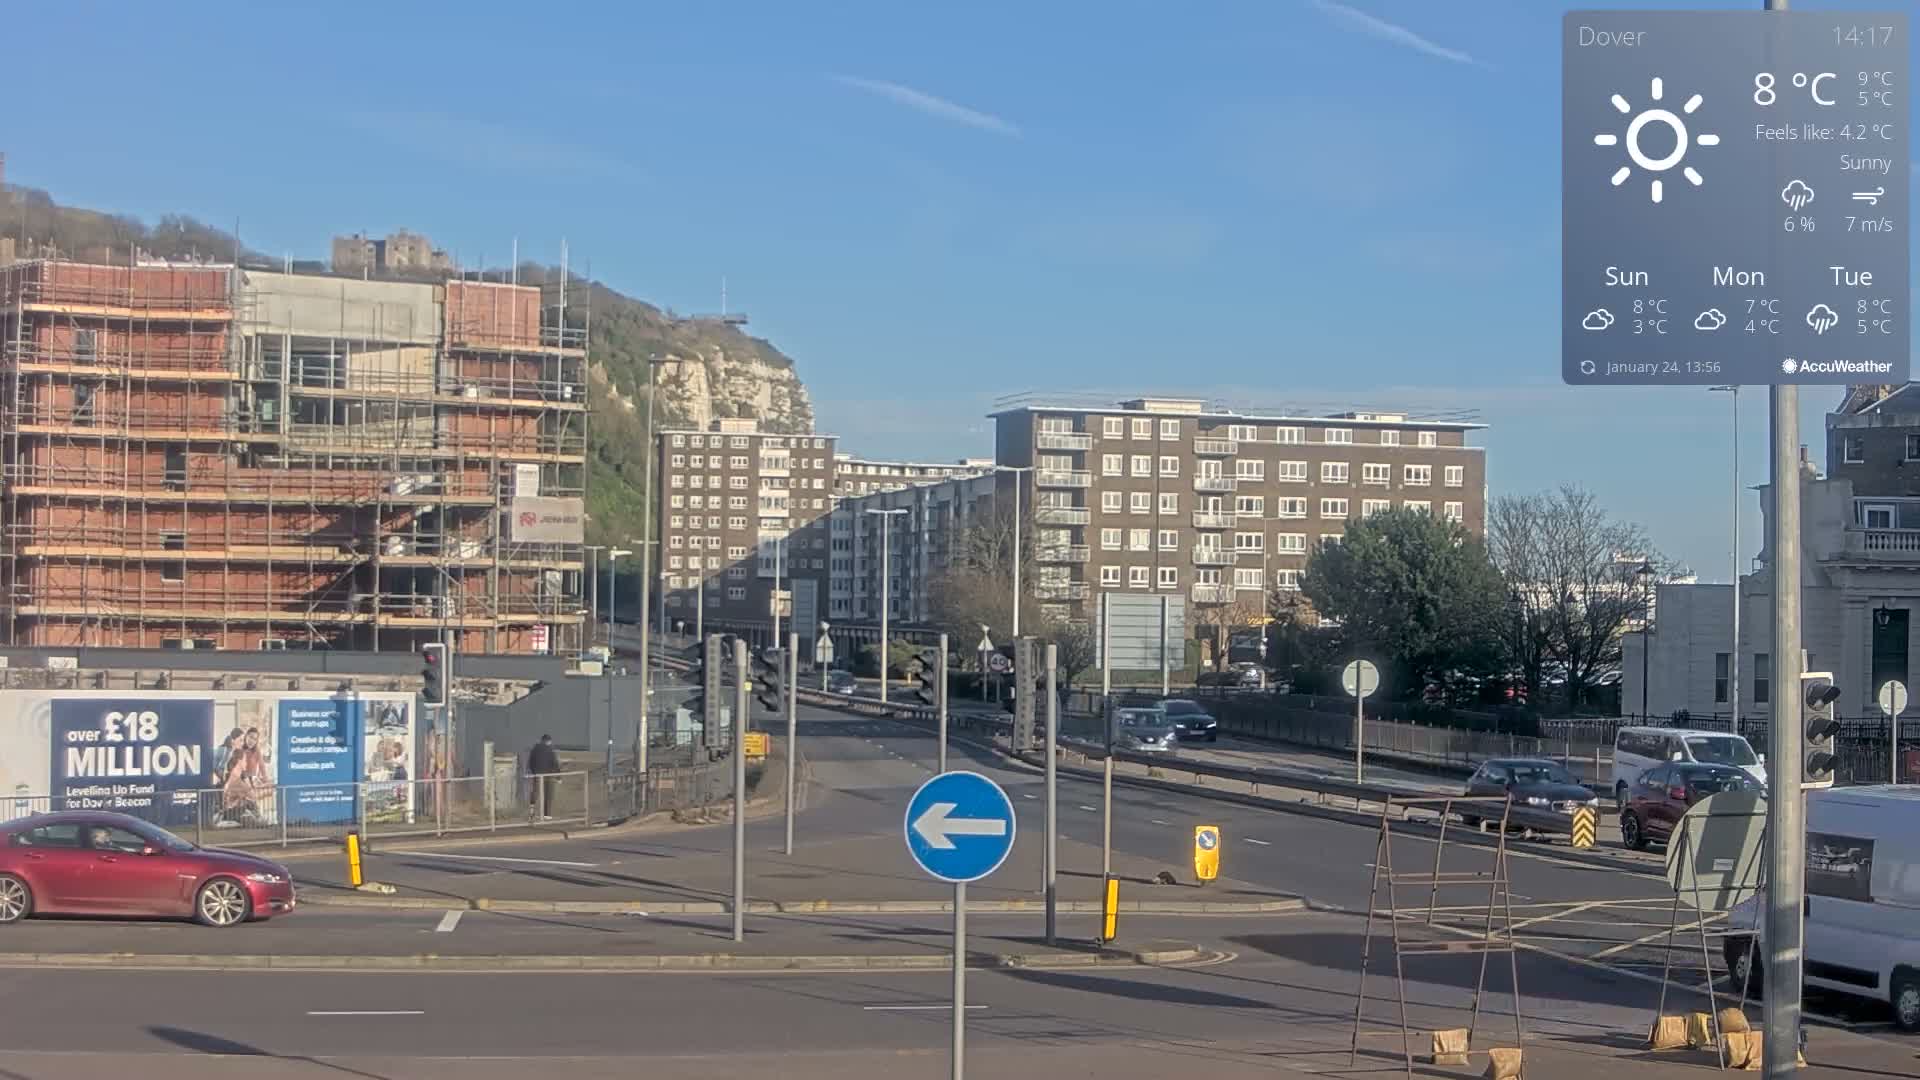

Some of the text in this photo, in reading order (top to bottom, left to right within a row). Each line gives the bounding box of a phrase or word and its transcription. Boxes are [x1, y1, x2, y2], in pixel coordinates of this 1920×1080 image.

[67, 711, 160, 742] over £18
[66, 744, 201, 778] MILLION
[129, 783, 155, 795] Fund
